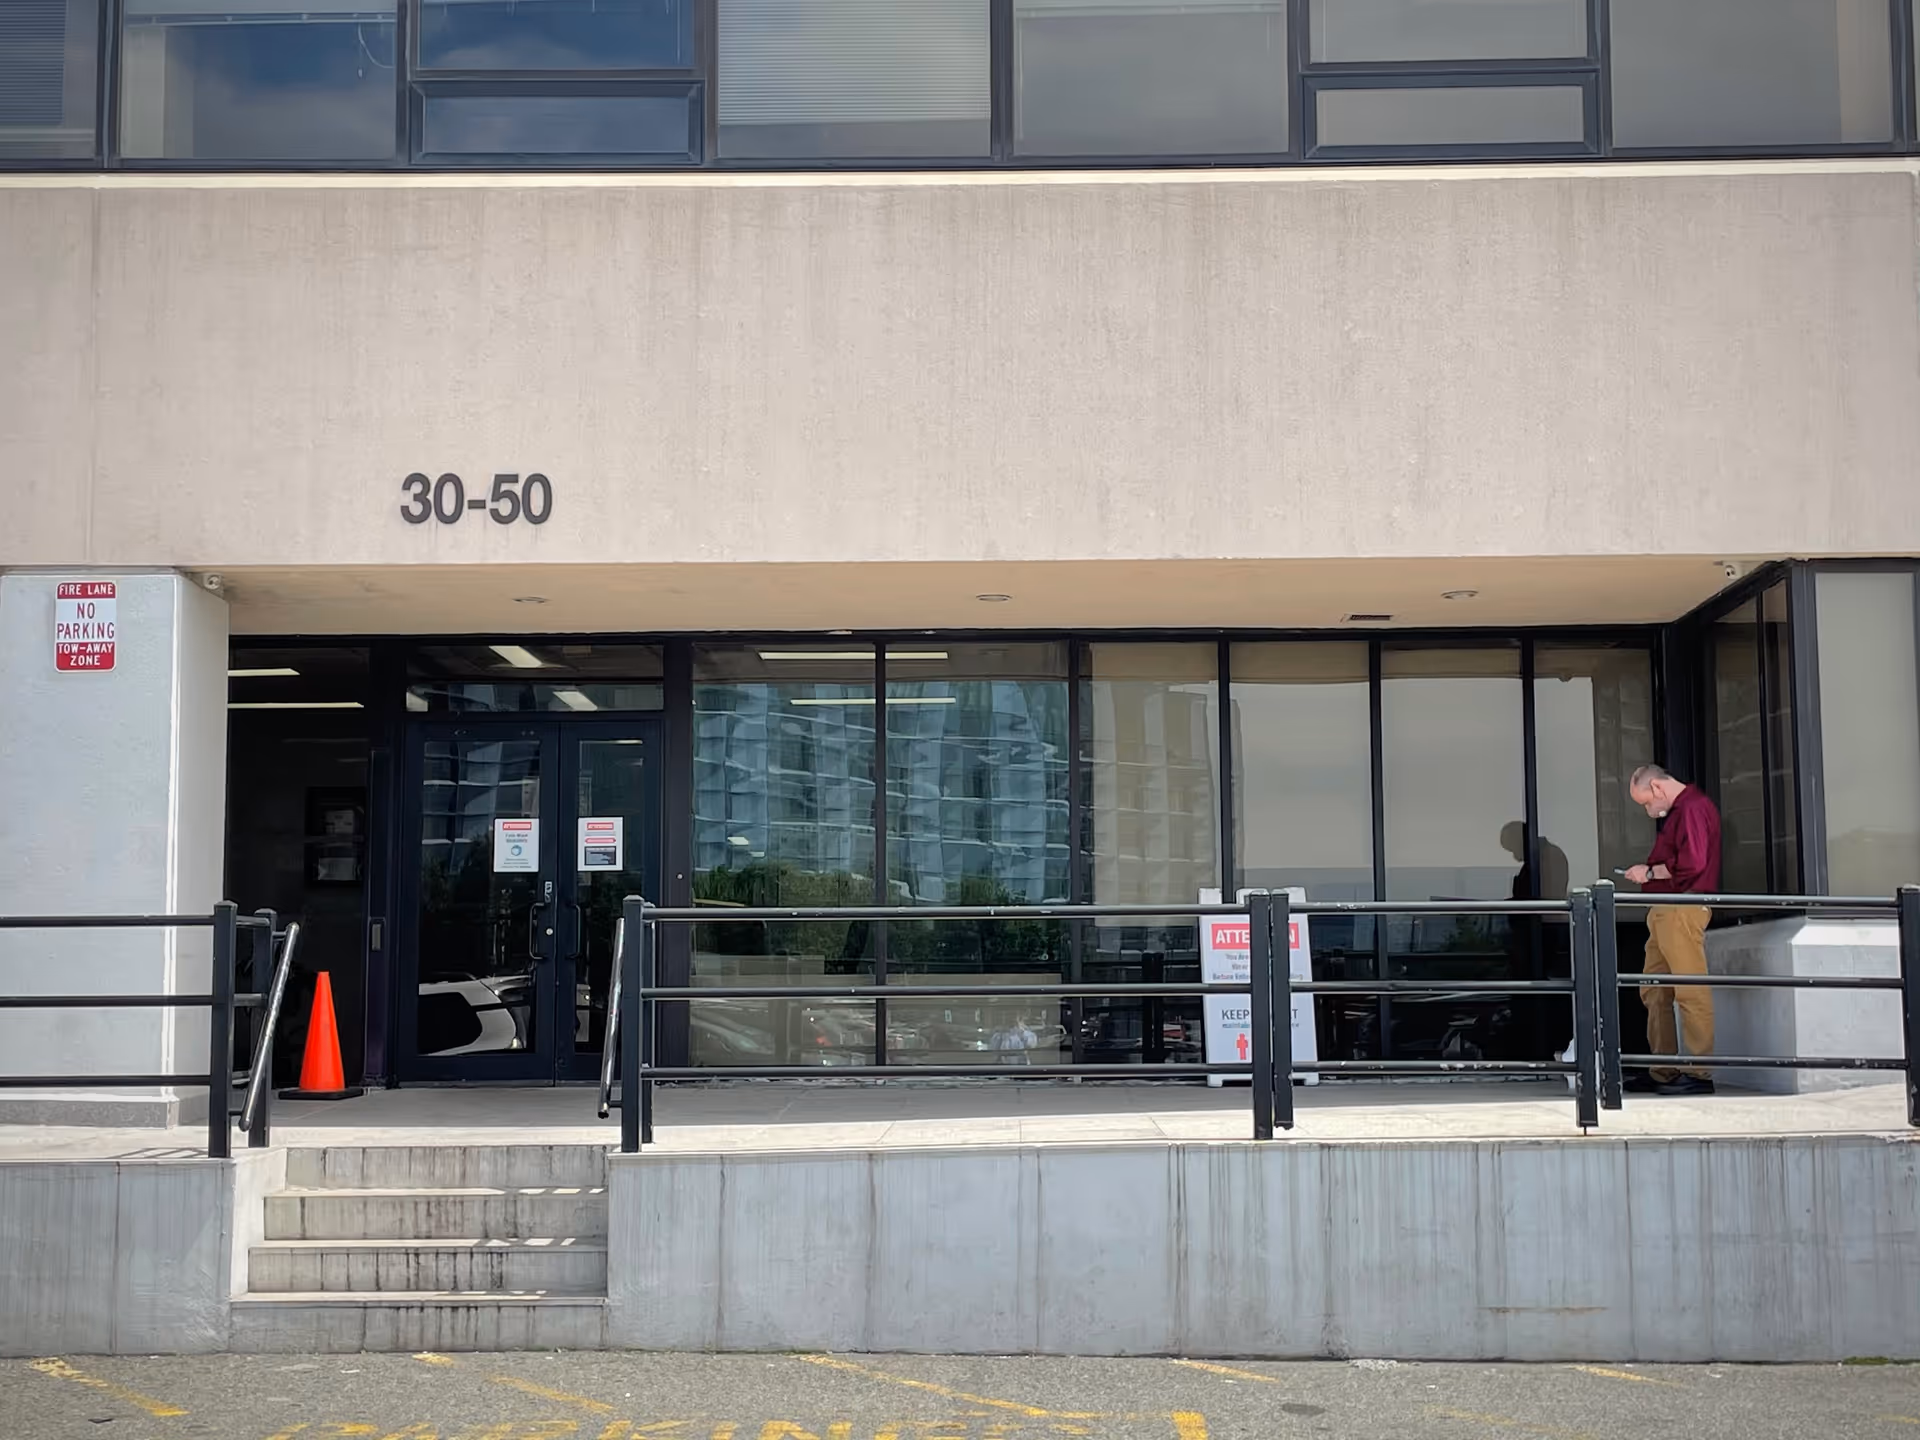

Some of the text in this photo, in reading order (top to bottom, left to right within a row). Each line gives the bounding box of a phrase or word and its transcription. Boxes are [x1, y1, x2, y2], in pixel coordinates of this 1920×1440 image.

[400, 472, 552, 525] 30-50
[59, 584, 113, 595] FIRE LANE
[77, 602, 95, 619] NO
[57, 622, 115, 640] PARKING
[58, 643, 113, 654] TOW-AWAY
[70, 655, 100, 666] ZONE
[1222, 1009, 1250, 1020] KEEP
